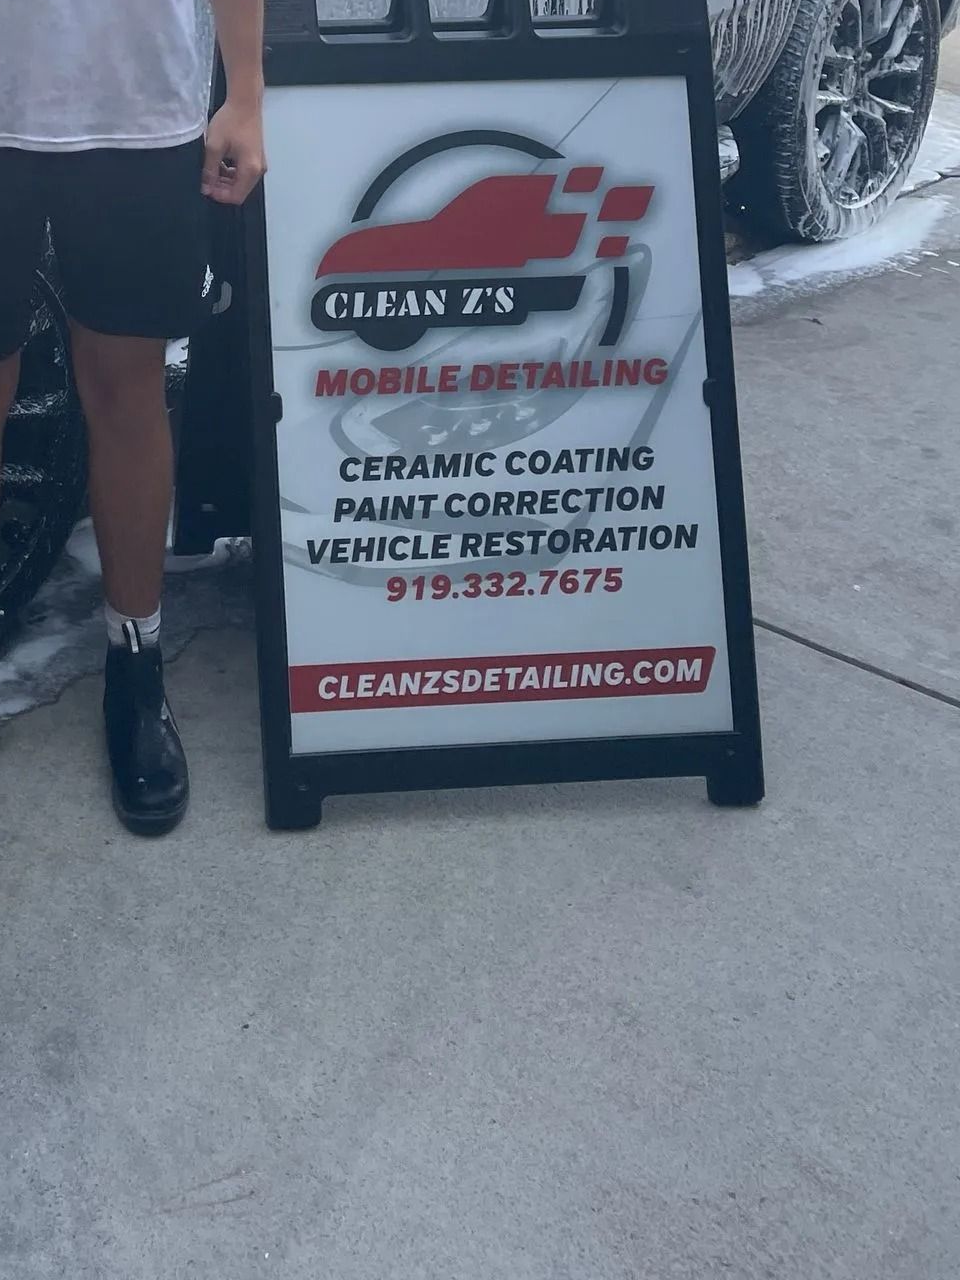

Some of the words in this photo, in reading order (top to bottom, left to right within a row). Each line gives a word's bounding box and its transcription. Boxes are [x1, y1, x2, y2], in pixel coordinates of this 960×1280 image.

[324, 289, 447, 320] CLEAN
[461, 285, 516, 315] Z'S
[315, 365, 461, 397] MOBILE
[470, 358, 669, 392] DETAILING
[339, 451, 496, 483] CERAMIC
[505, 446, 654, 477] COATING
[333, 493, 438, 523] PAINT
[444, 485, 665, 519] CORRECTION
[306, 533, 451, 565] VEHICLE
[460, 524, 699, 558] RESTORATION
[386, 567, 624, 602] 919.332.7675
[318, 658, 703, 701] CLEANZSDETAILING.COM
